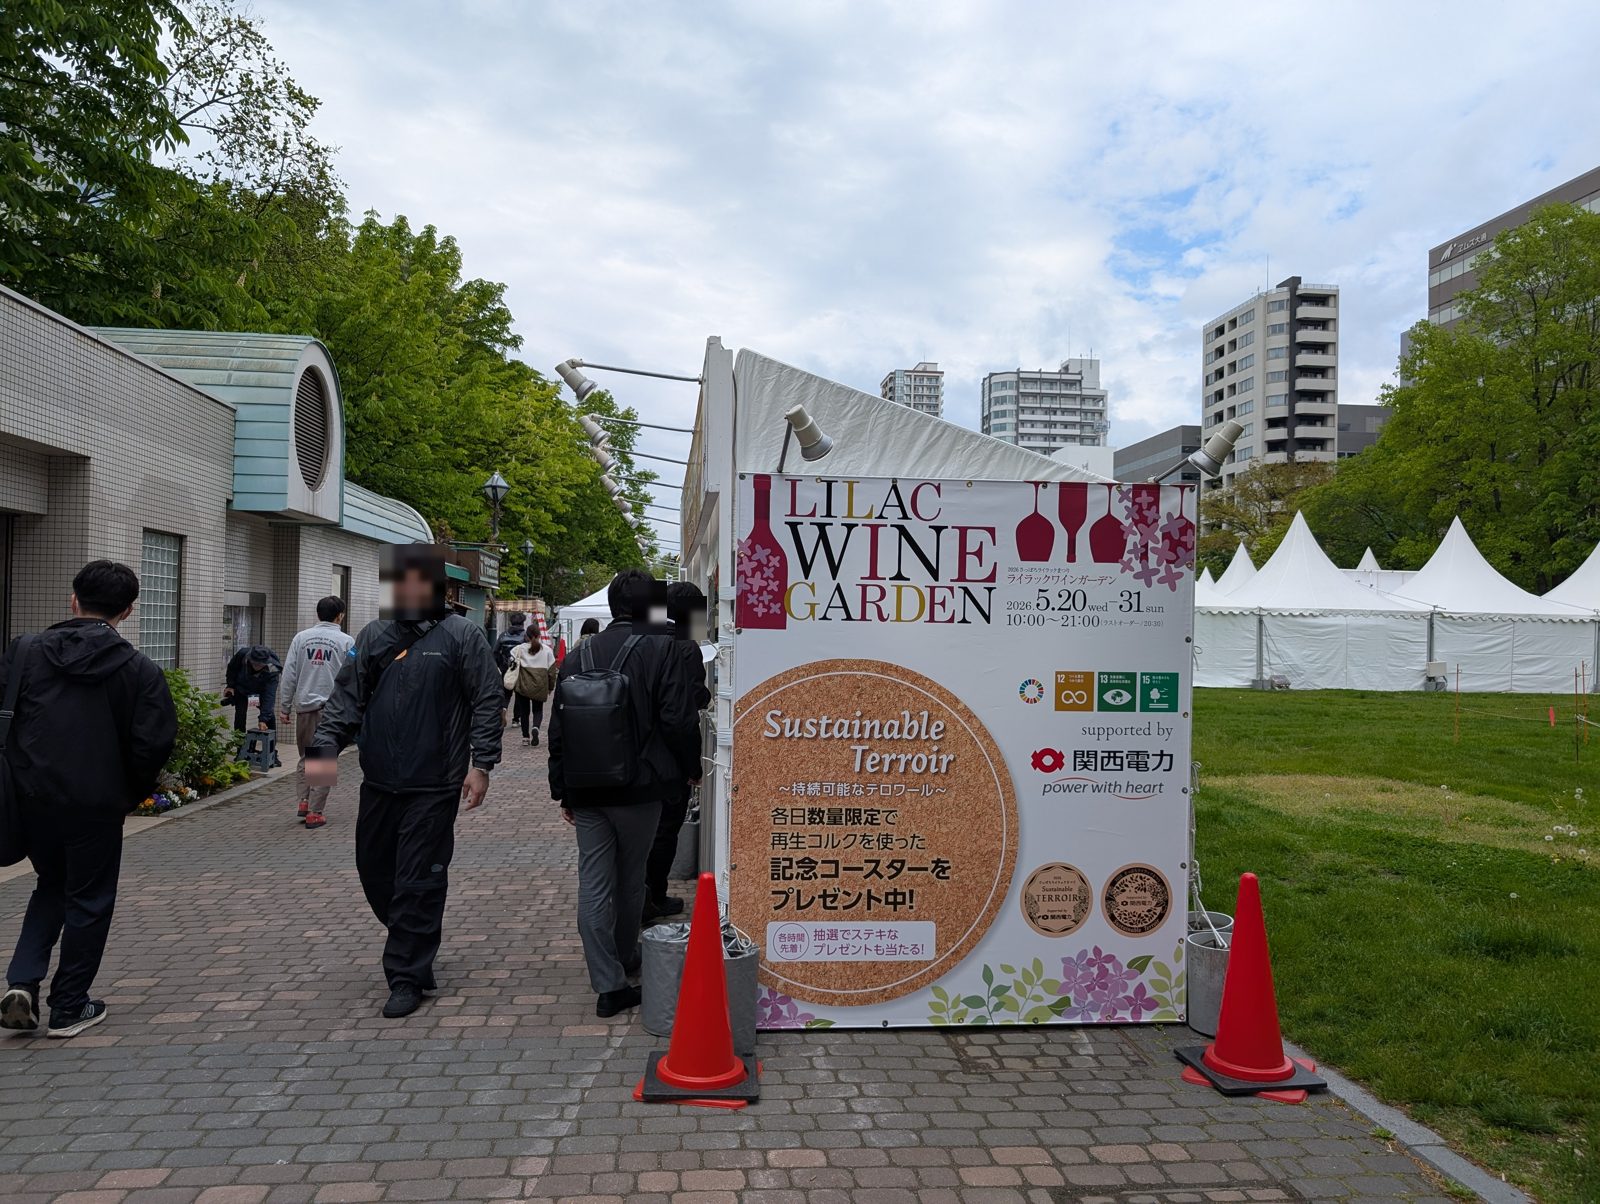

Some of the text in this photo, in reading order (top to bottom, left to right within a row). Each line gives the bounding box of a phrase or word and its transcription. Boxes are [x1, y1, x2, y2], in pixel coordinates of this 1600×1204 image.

[785, 478, 942, 522] LILAC
[784, 521, 997, 583] WINE
[1007, 573, 1117, 586] ライラックワインガーデン
[783, 581, 996, 625] GARDEN
[306, 648, 332, 661] VAN
[1057, 674, 1065, 684] 12
[1100, 674, 1108, 684] 13
[1142, 675, 1150, 684] 15
[764, 709, 945, 741] Sustainable
[1081, 721, 1174, 742] supported by
[850, 745, 954, 774] Terroir
[1073, 750, 1174, 773] 関西電力
[1042, 781, 1164, 796] power with heart
[771, 807, 898, 827] 各日数量限定で
[770, 832, 926, 851] 再生コルクを使った
[770, 857, 952, 881] 記念コースターを
[771, 886, 914, 912] プレゼント中!
[1036, 894, 1079, 902] TERROIR
[777, 932, 805, 943] 各時間
[813, 928, 899, 940] 抽選でステキな
[813, 943, 925, 956] プレゼントも当たる!
